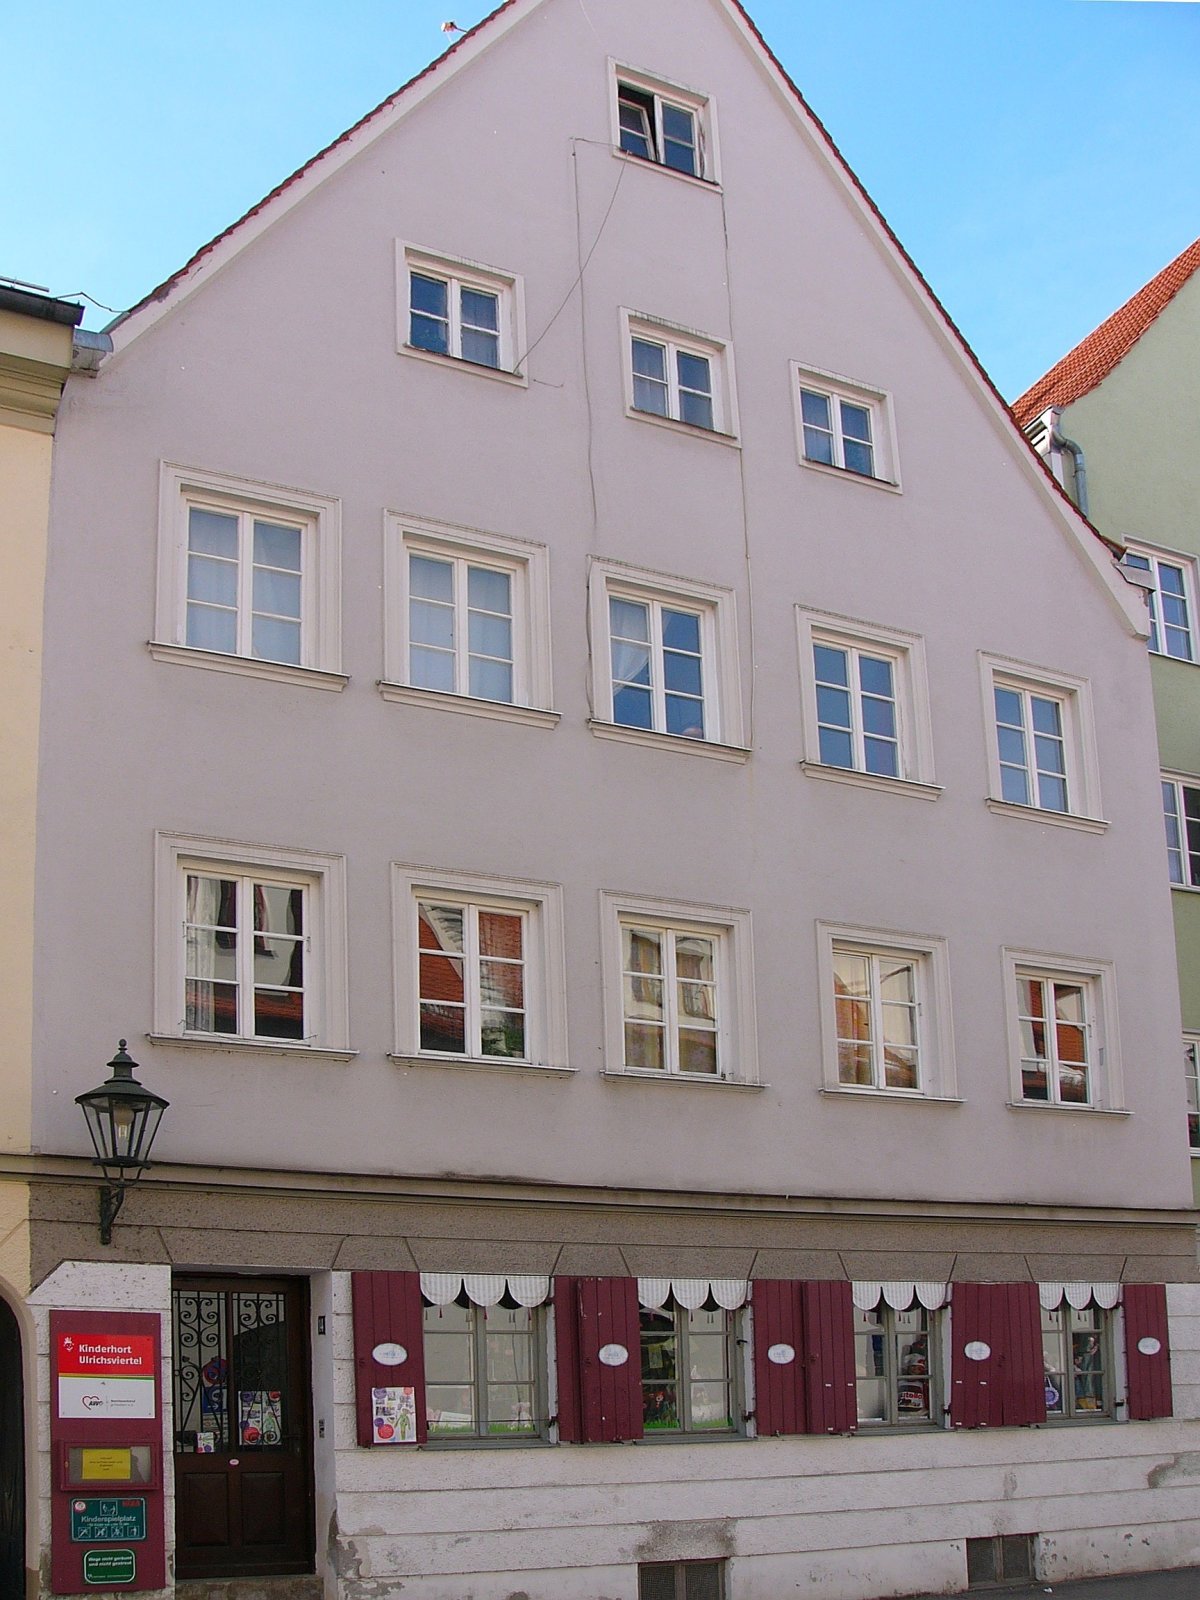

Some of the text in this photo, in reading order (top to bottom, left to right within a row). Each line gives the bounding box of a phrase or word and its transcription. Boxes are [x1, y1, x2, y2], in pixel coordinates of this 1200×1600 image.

[79, 1344, 132, 1354] Kinderhort
[79, 1355, 142, 1365] Ulrichsviertel
[81, 1515, 136, 1523] Kinderspielplatz
